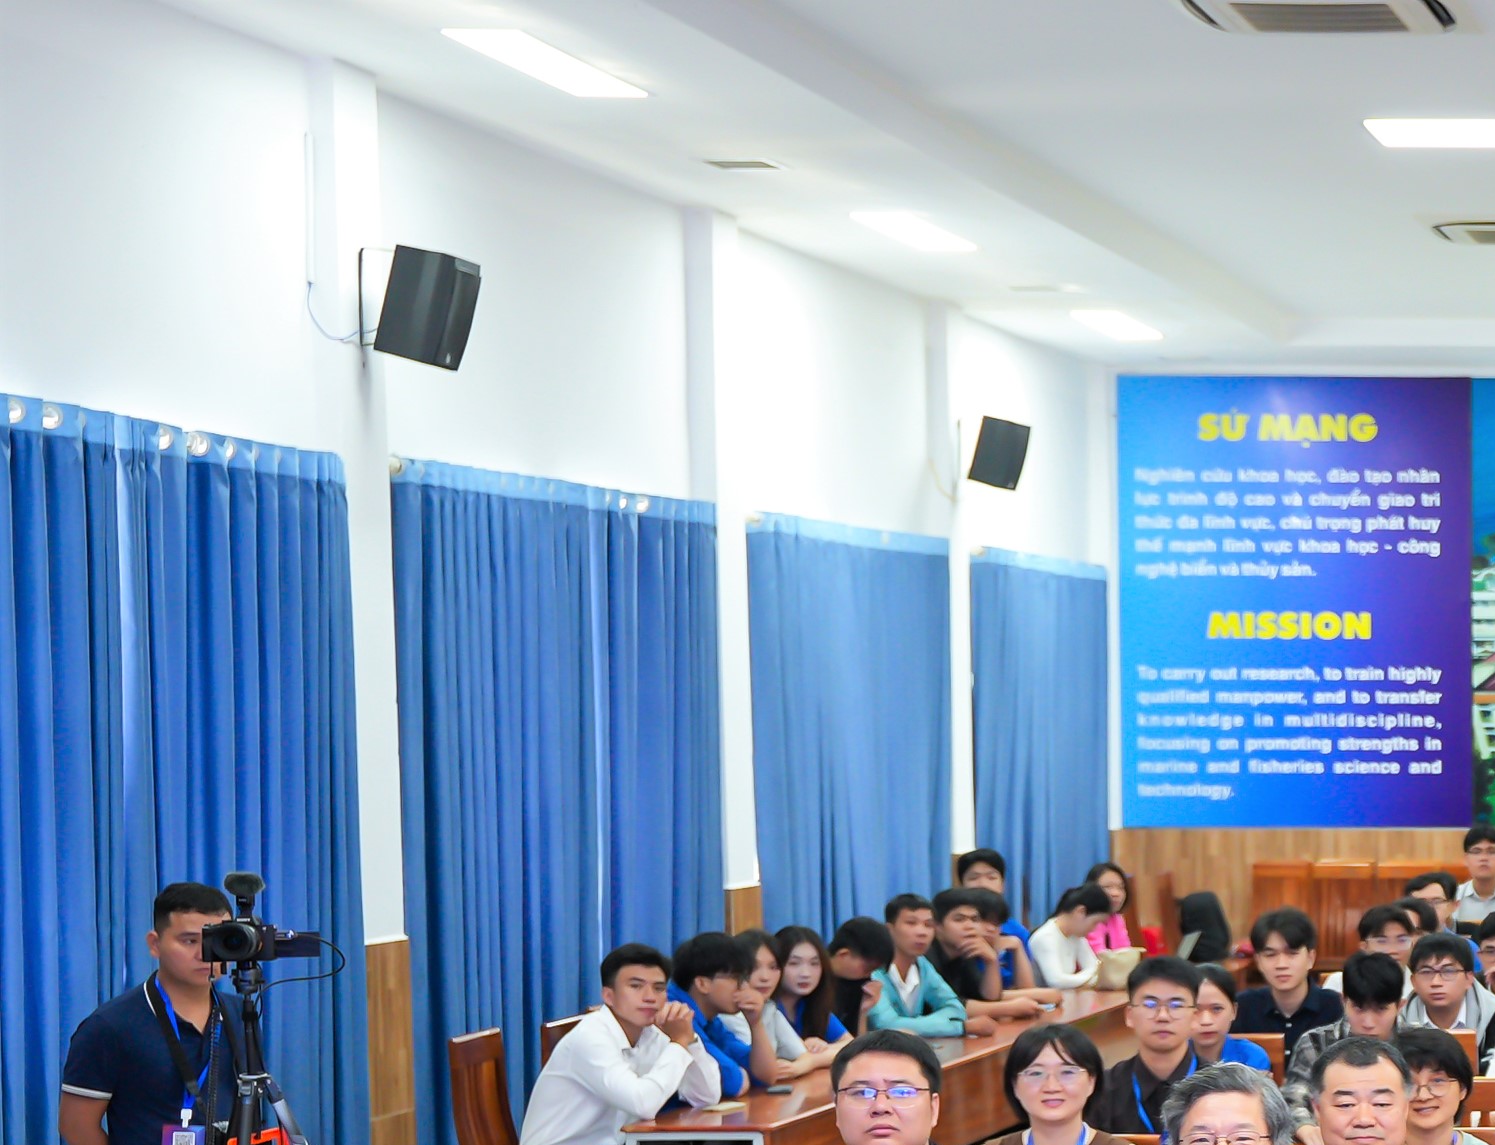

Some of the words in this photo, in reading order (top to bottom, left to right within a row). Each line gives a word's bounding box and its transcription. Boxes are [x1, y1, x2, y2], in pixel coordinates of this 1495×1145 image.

[1198, 408, 1248, 441] SỨ
[1258, 413, 1379, 448] MẠNG
[1377, 492, 1415, 510] giao
[1207, 611, 1373, 640] MISSION
[1209, 666, 1237, 680] out
[1323, 667, 1342, 680] to
[1344, 666, 1384, 680] train
[1387, 666, 1442, 684] highly
[1136, 688, 1210, 705] qualified
[1312, 689, 1346, 704] and
[1351, 690, 1370, 704] to
[1374, 689, 1442, 704] transfer
[1136, 712, 1244, 730] knowledge
[1253, 713, 1274, 726] in
[1136, 735, 1210, 753] focusing
[1216, 737, 1238, 750] on
[1244, 736, 1332, 754] promoting
[1337, 736, 1418, 754] strengths
[1424, 736, 1442, 750] in
[1137, 760, 1198, 773] marine
[1206, 759, 1240, 774] and
[1248, 758, 1324, 774] fisheries
[1332, 760, 1400, 774] science
[1408, 759, 1442, 774] and
